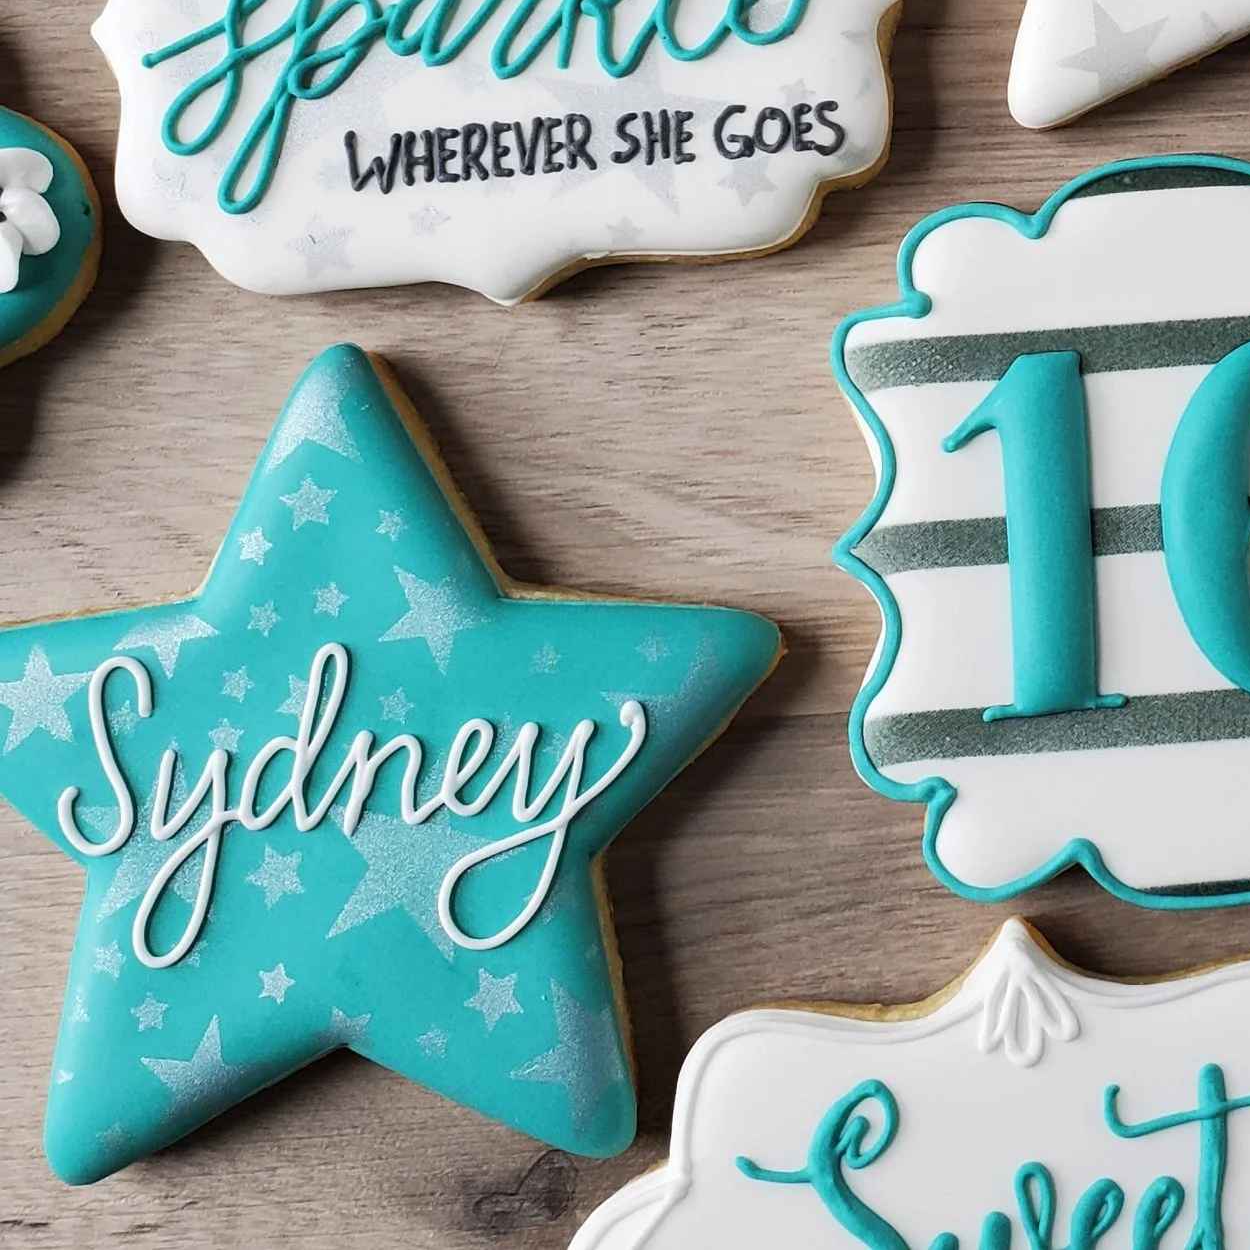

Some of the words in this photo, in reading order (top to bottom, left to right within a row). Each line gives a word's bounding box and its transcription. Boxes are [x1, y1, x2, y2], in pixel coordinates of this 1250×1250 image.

[343, 112, 599, 196] WHEREVER
[610, 109, 697, 167] SHE
[712, 99, 847, 161] GOES
[57, 642, 647, 968] Sydney
